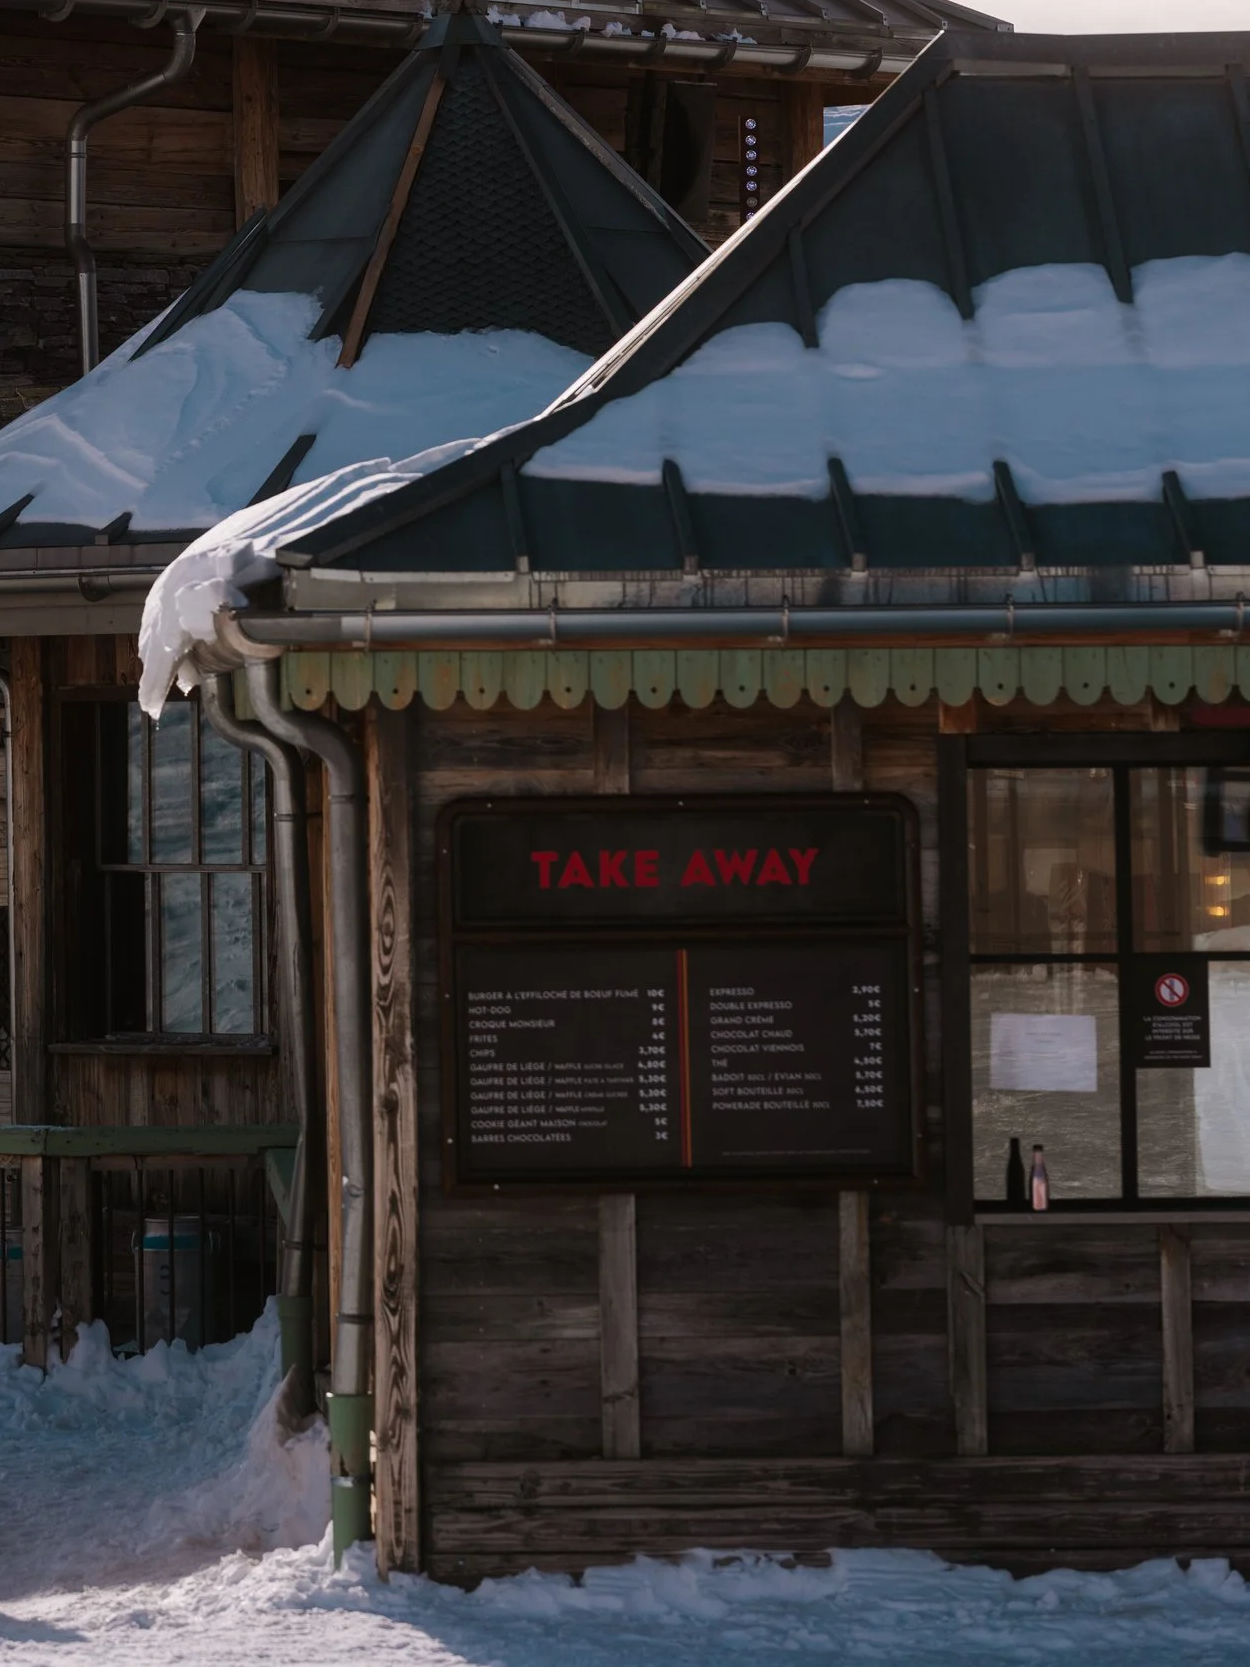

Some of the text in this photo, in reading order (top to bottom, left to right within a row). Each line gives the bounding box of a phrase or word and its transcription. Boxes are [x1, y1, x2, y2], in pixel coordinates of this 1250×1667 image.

[530, 847, 820, 890] TAKE AWAY
[467, 991, 504, 1001] BURGER
[569, 990, 582, 999] DE
[614, 987, 639, 999] FUMÉ
[646, 988, 665, 998] 10€
[709, 986, 755, 997] EXPRESSO
[468, 1005, 512, 1015] HOT-DOG
[709, 1001, 746, 1011] DOUBLE
[746, 1000, 793, 1010] EXPRESSO
[468, 1019, 507, 1030] CROQUE
[508, 1018, 556, 1029] MONSIEUR
[709, 1015, 744, 1025] GRAND
[469, 1033, 499, 1044] FRITES
[709, 1029, 760, 1040] CHOCOLAT
[761, 1029, 794, 1039] CHAUD
[469, 1048, 496, 1058] CHIPS
[710, 1044, 760, 1054] CHOCOLAT
[761, 1043, 805, 1053] VIENNOIS
[469, 1062, 504, 1072] GAUFRE
[506, 1061, 518, 1071] DE
[710, 1057, 729, 1068] THÉ
[469, 1077, 504, 1087] GAUFRE
[506, 1076, 518, 1086] DE
[711, 1072, 745, 1083] BADOIT
[469, 1091, 504, 1101] GAUFRE
[506, 1090, 518, 1100] DE
[711, 1087, 735, 1097] SOFT
[736, 1086, 784, 1096] BOUTEILLE
[470, 1106, 505, 1116] GAUFRE
[506, 1105, 518, 1115] DE
[712, 1101, 761, 1111] POWERADE
[762, 1100, 810, 1110] BOUTEILLE
[470, 1119, 505, 1129] COOKIE
[539, 1118, 577, 1128] MAISON
[471, 1133, 506, 1143] BARRES
